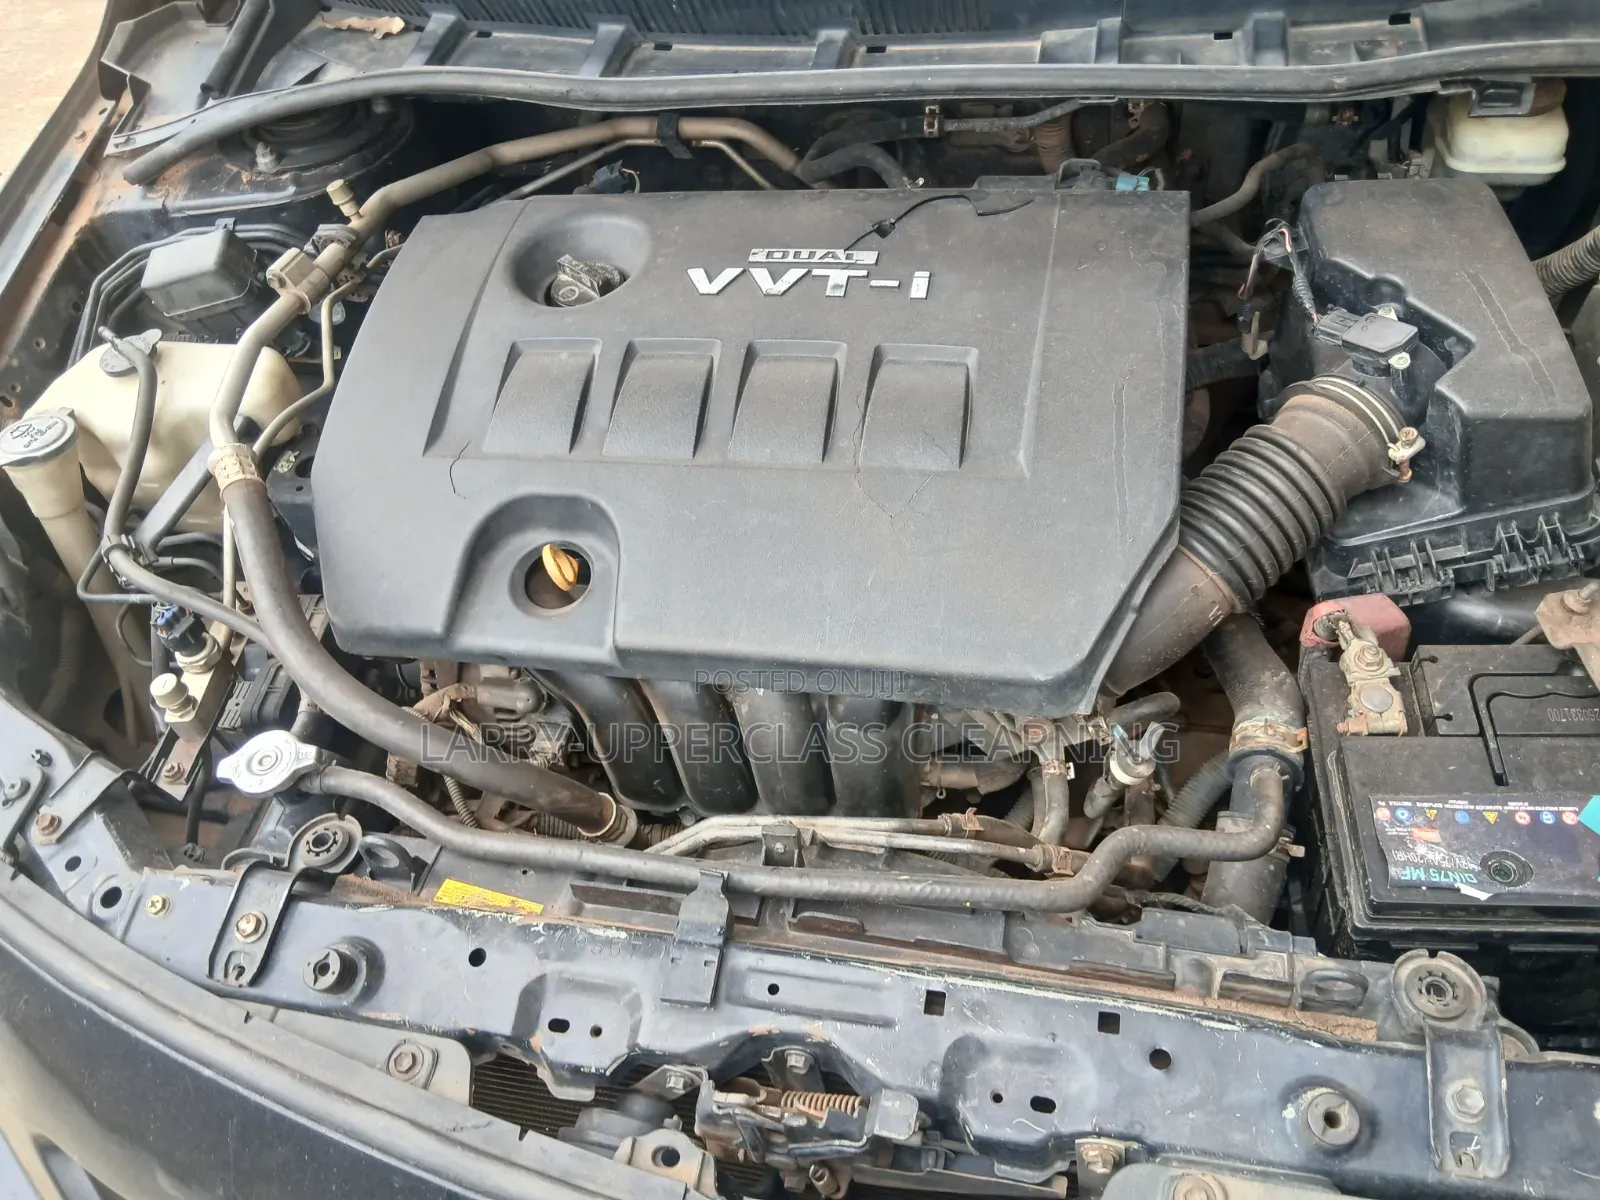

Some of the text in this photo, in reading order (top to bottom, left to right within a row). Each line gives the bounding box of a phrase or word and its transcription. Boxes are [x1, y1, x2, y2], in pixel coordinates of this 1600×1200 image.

[763, 249, 864, 263] DUAL
[1400, 866, 1478, 884] DIN75 MF
